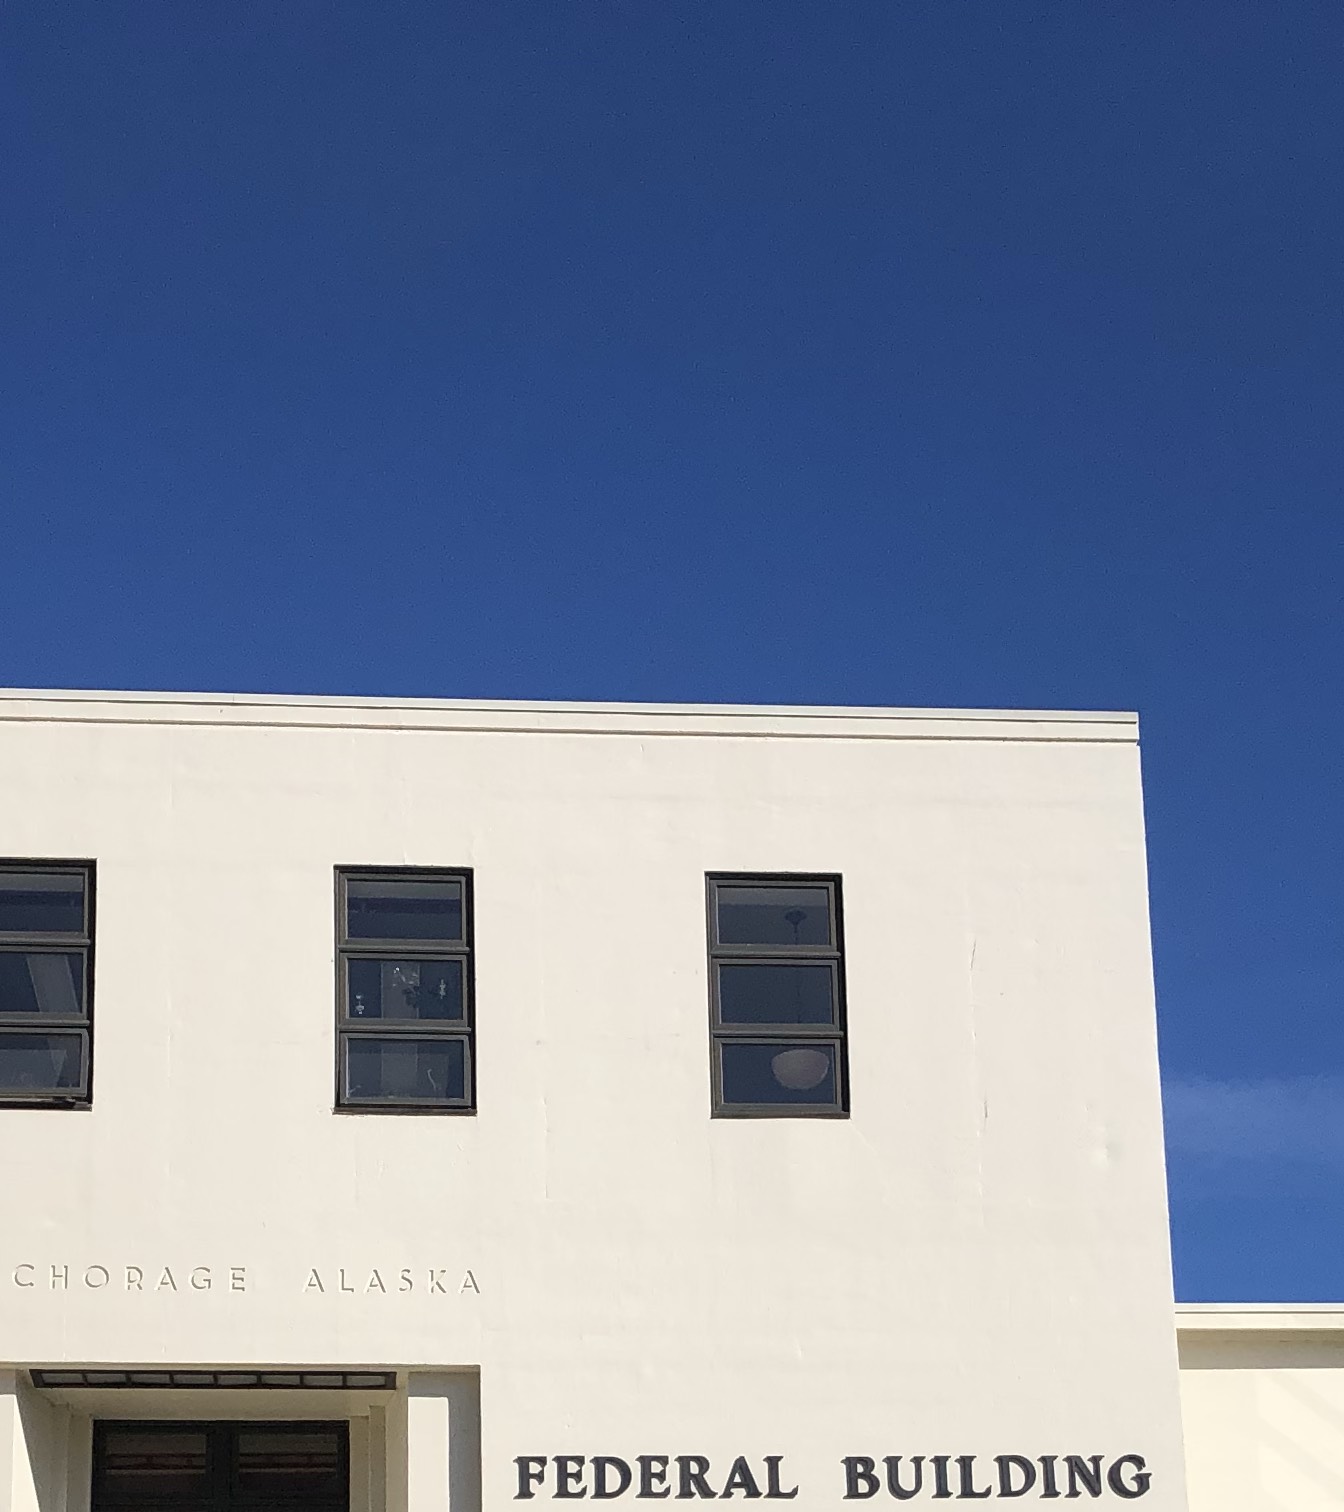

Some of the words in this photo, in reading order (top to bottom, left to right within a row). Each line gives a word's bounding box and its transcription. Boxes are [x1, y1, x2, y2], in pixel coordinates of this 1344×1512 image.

[301, 1267, 482, 1295] ALASKA
[513, 1454, 800, 1502] FEDERAL
[841, 1454, 1153, 1501] BUILDING
